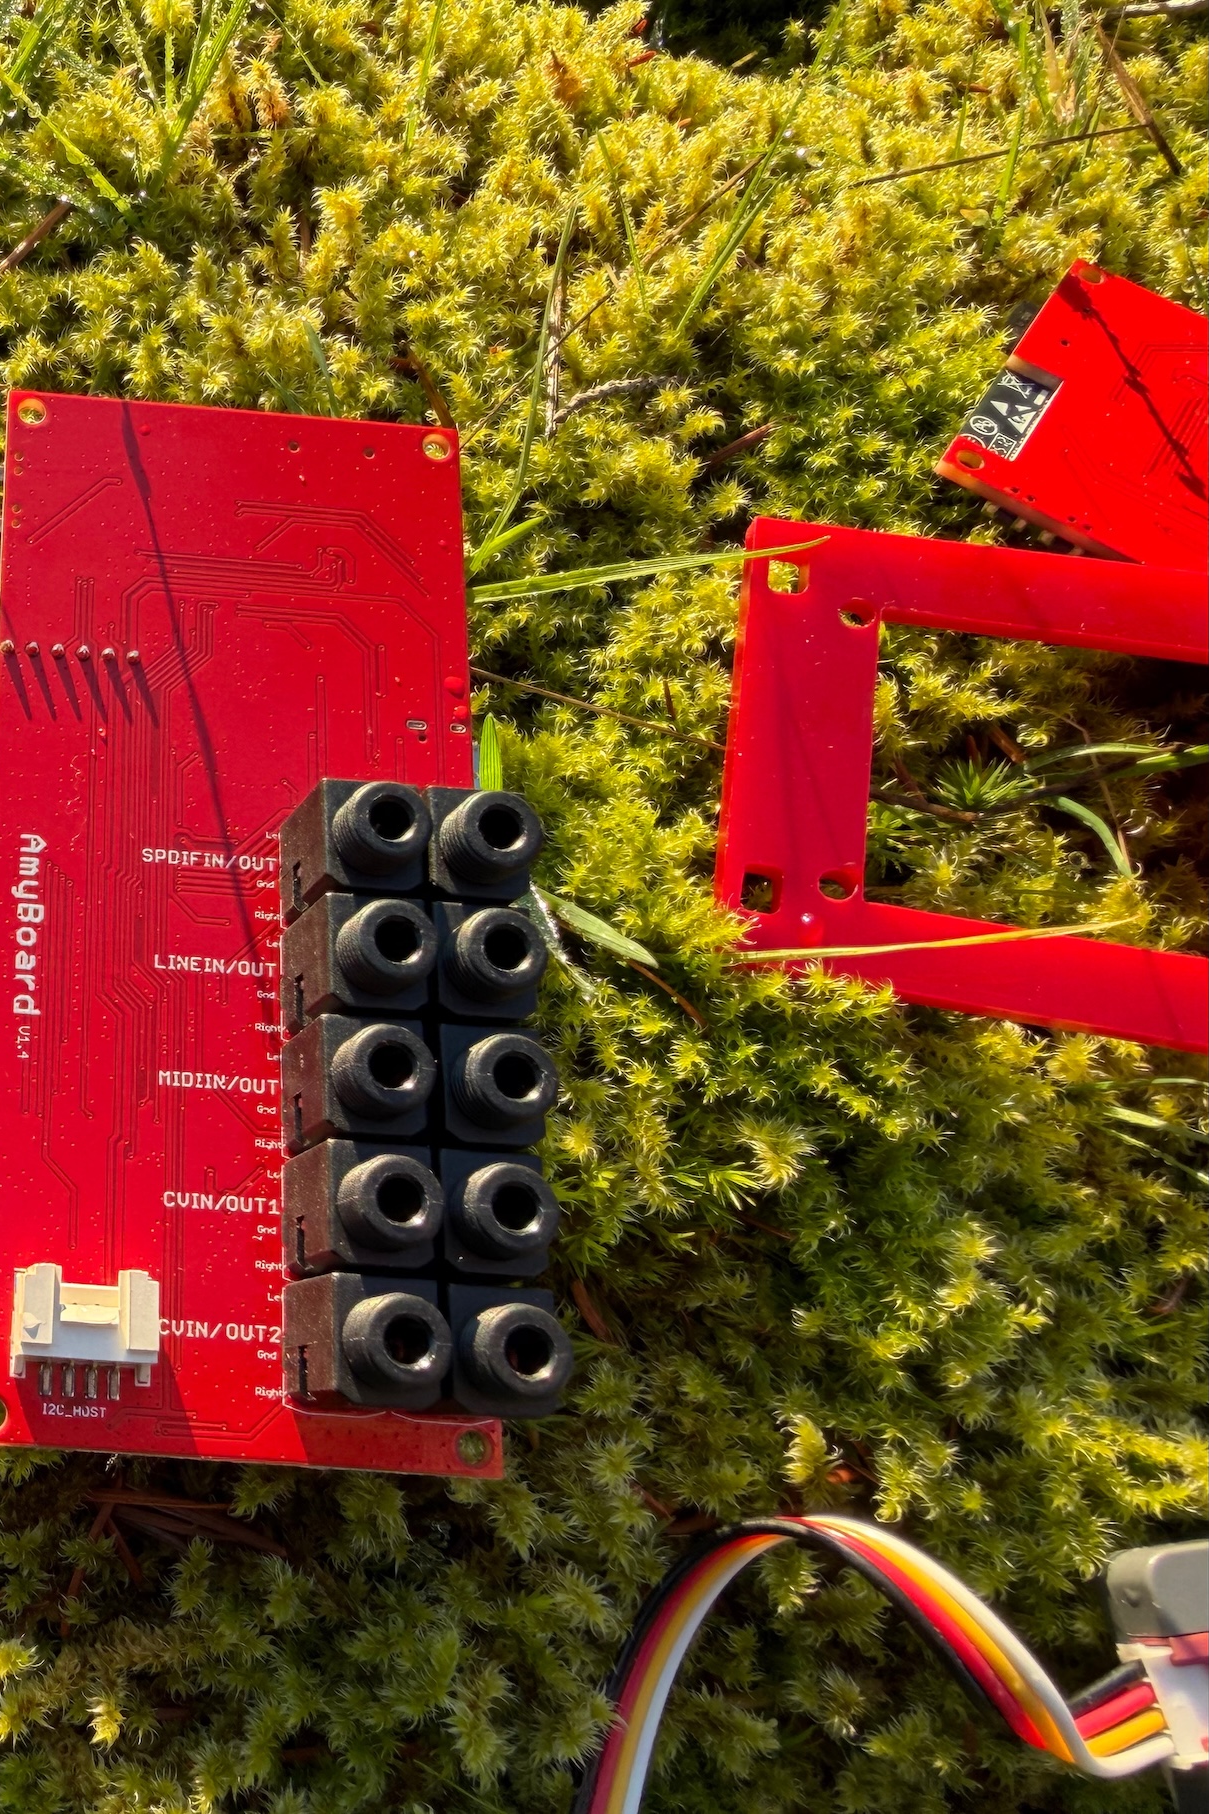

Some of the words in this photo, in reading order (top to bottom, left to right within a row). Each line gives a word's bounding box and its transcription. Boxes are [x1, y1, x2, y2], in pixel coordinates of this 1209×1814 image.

[141, 848, 278, 872] SPDIFIN/OUT
[256, 879, 275, 889] Gnd
[11, 833, 47, 1016] AmyBoard
[154, 953, 277, 978] LINEIN/OUT
[256, 990, 276, 1000] Gnd
[158, 1070, 279, 1096] MIDIIN/OUT
[163, 1191, 281, 1215] CVIN/OUT1
[257, 1225, 277, 1235] Gnd
[159, 1318, 281, 1344] CVIN/OUT2
[257, 1349, 277, 1361] Gnd
[42, 1402, 107, 1419] I2C_HOST
